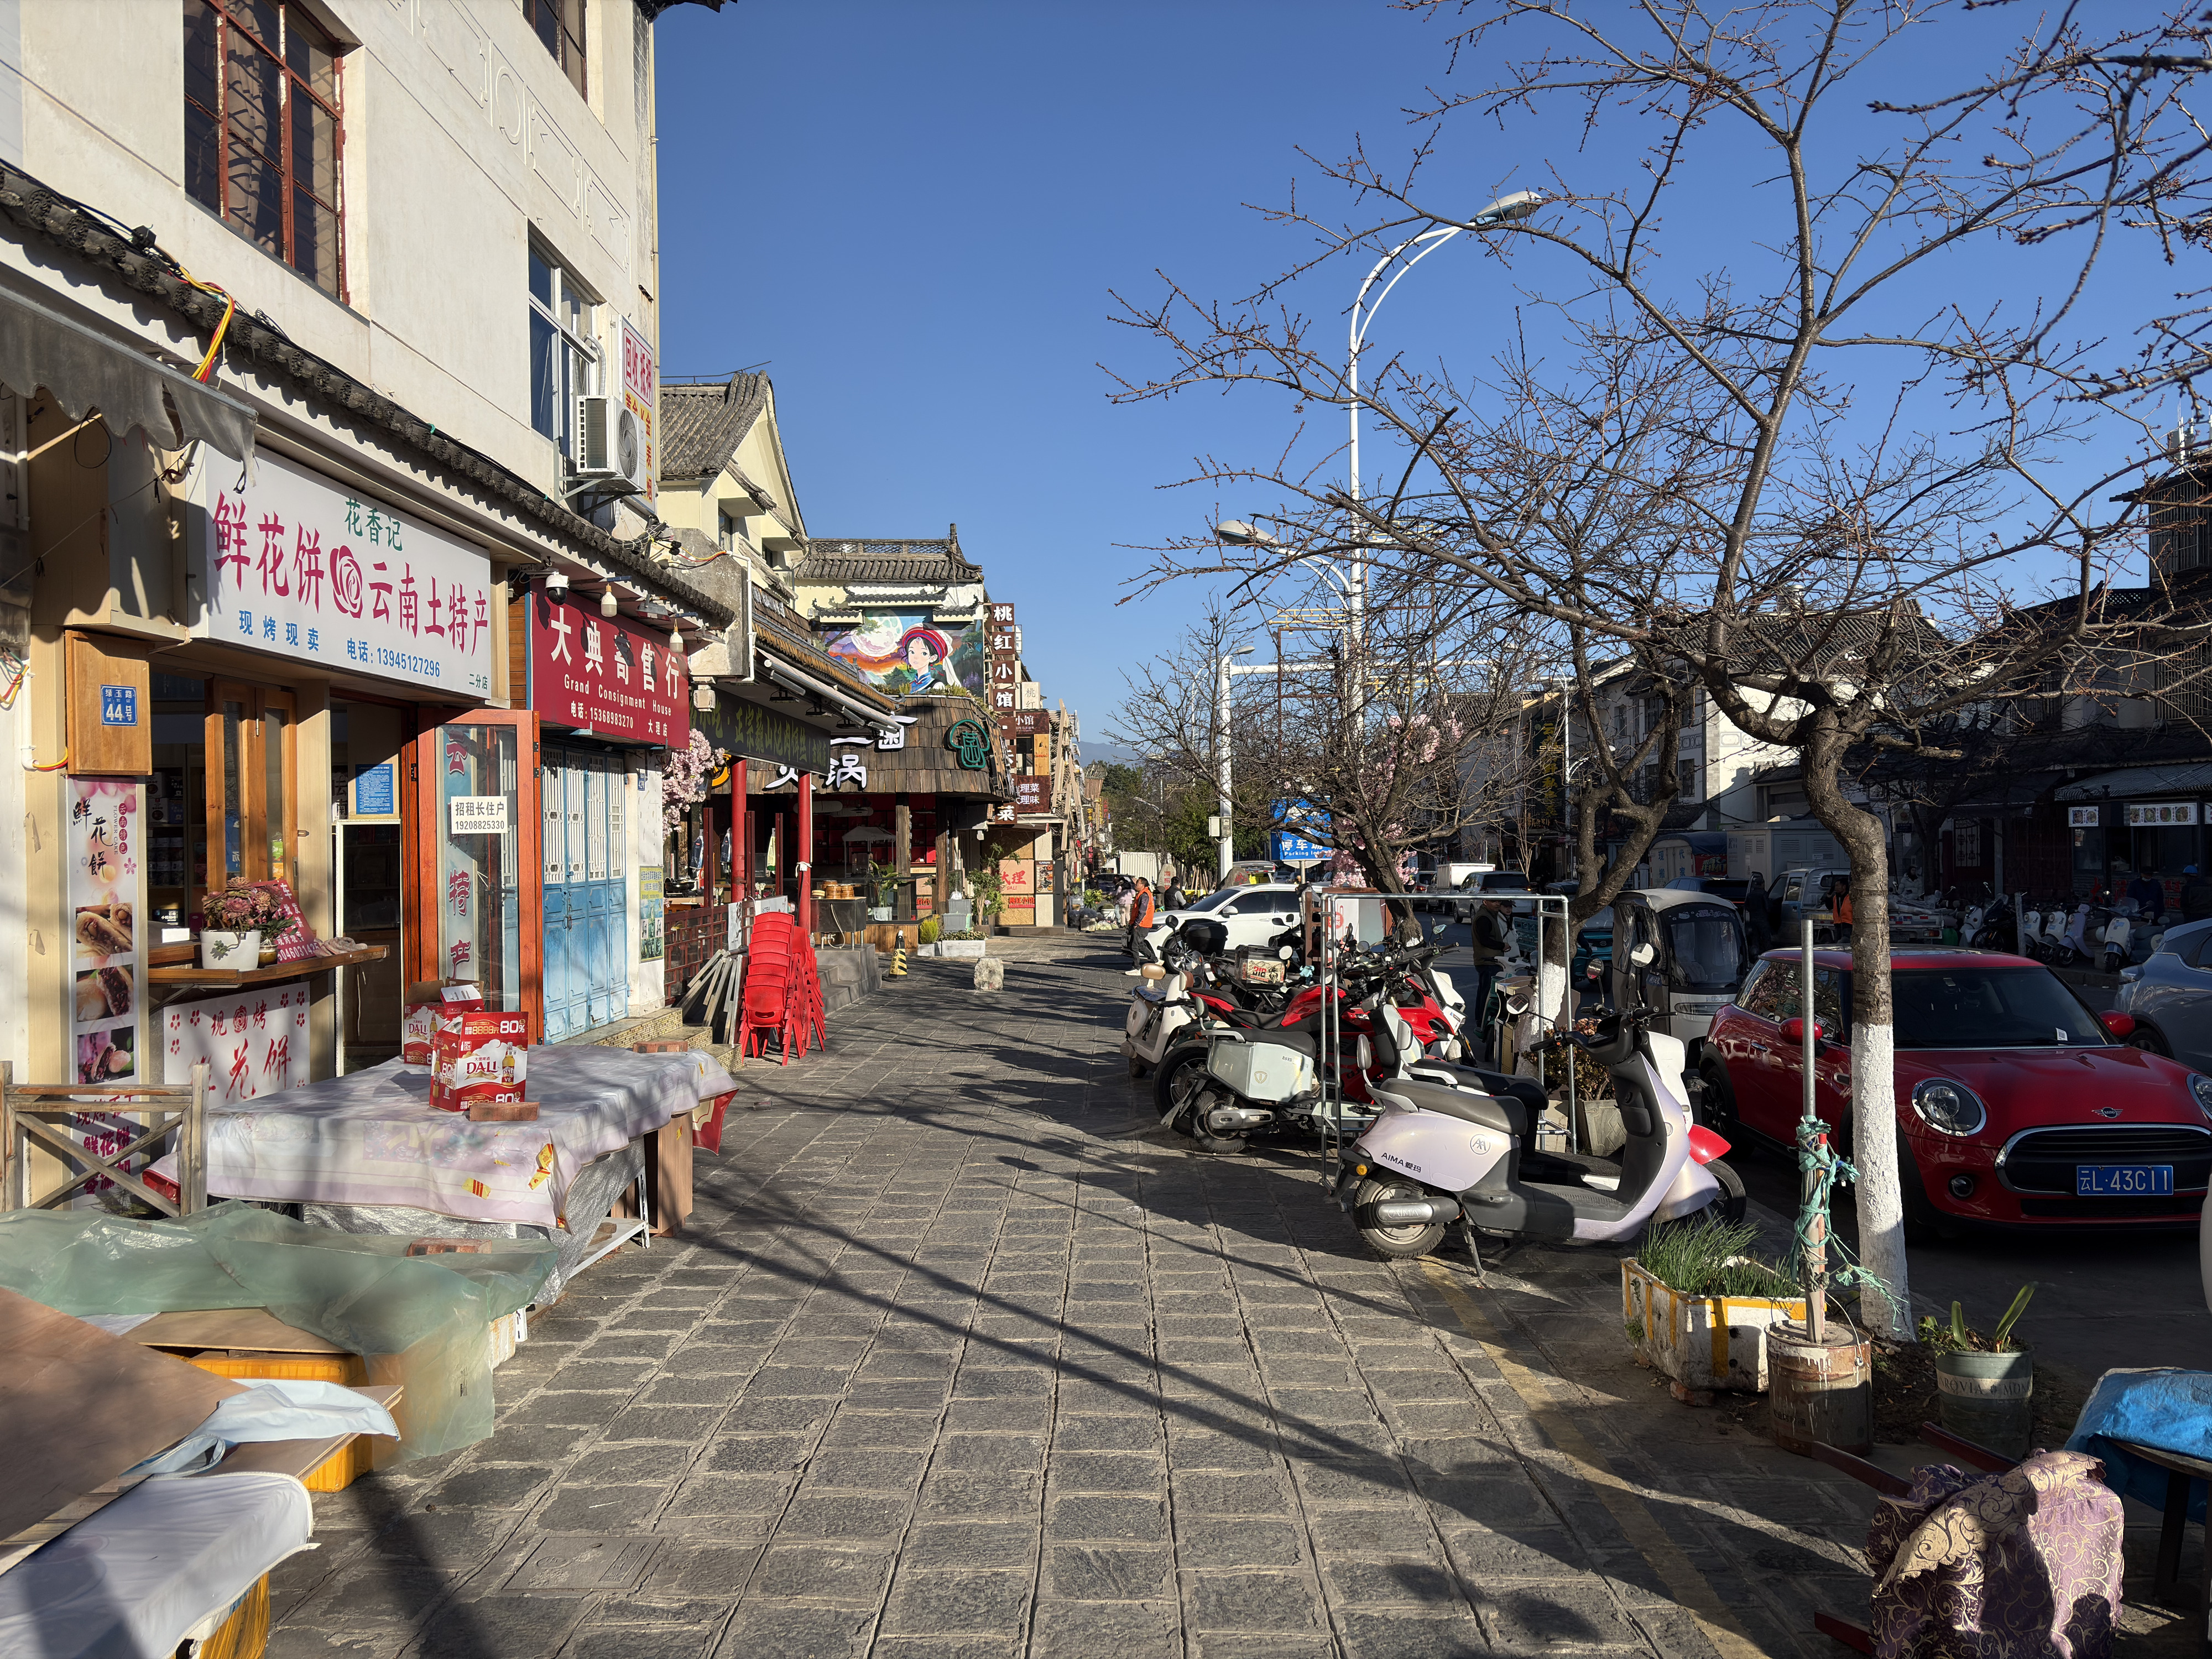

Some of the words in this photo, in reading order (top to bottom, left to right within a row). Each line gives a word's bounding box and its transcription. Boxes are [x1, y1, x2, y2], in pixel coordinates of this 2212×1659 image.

[625, 336, 651, 403] 回收抵押
[344, 497, 403, 551] 花香记
[212, 489, 325, 613] 鲜花饼
[368, 561, 488, 656] 云南土特产
[239, 610, 320, 651] 现烤现卖
[550, 607, 679, 699] 大典寄售行
[468, 672, 488, 690] 二分店
[564, 674, 589, 695] Grand
[598, 684, 645, 709] Consignment
[653, 701, 671, 716] House
[106, 703, 132, 721] 44号
[648, 719, 667, 737] 大理店
[1016, 783, 1040, 793] 理菜
[455, 801, 505, 817] 招租长住户
[119, 804, 127, 854] 云南特色
[455, 820, 505, 831] 19208825330
[446, 729, 471, 980] 云特产
[1657, 849, 1684, 861] 现代
[1658, 866, 1685, 879] 搬家
[409, 1024, 428, 1035] DALI
[472, 1026, 499, 1035] 8888元
[500, 1020, 525, 1034] 80%
[188, 1035, 292, 1100] 花饼
[466, 1061, 498, 1074] DALI
